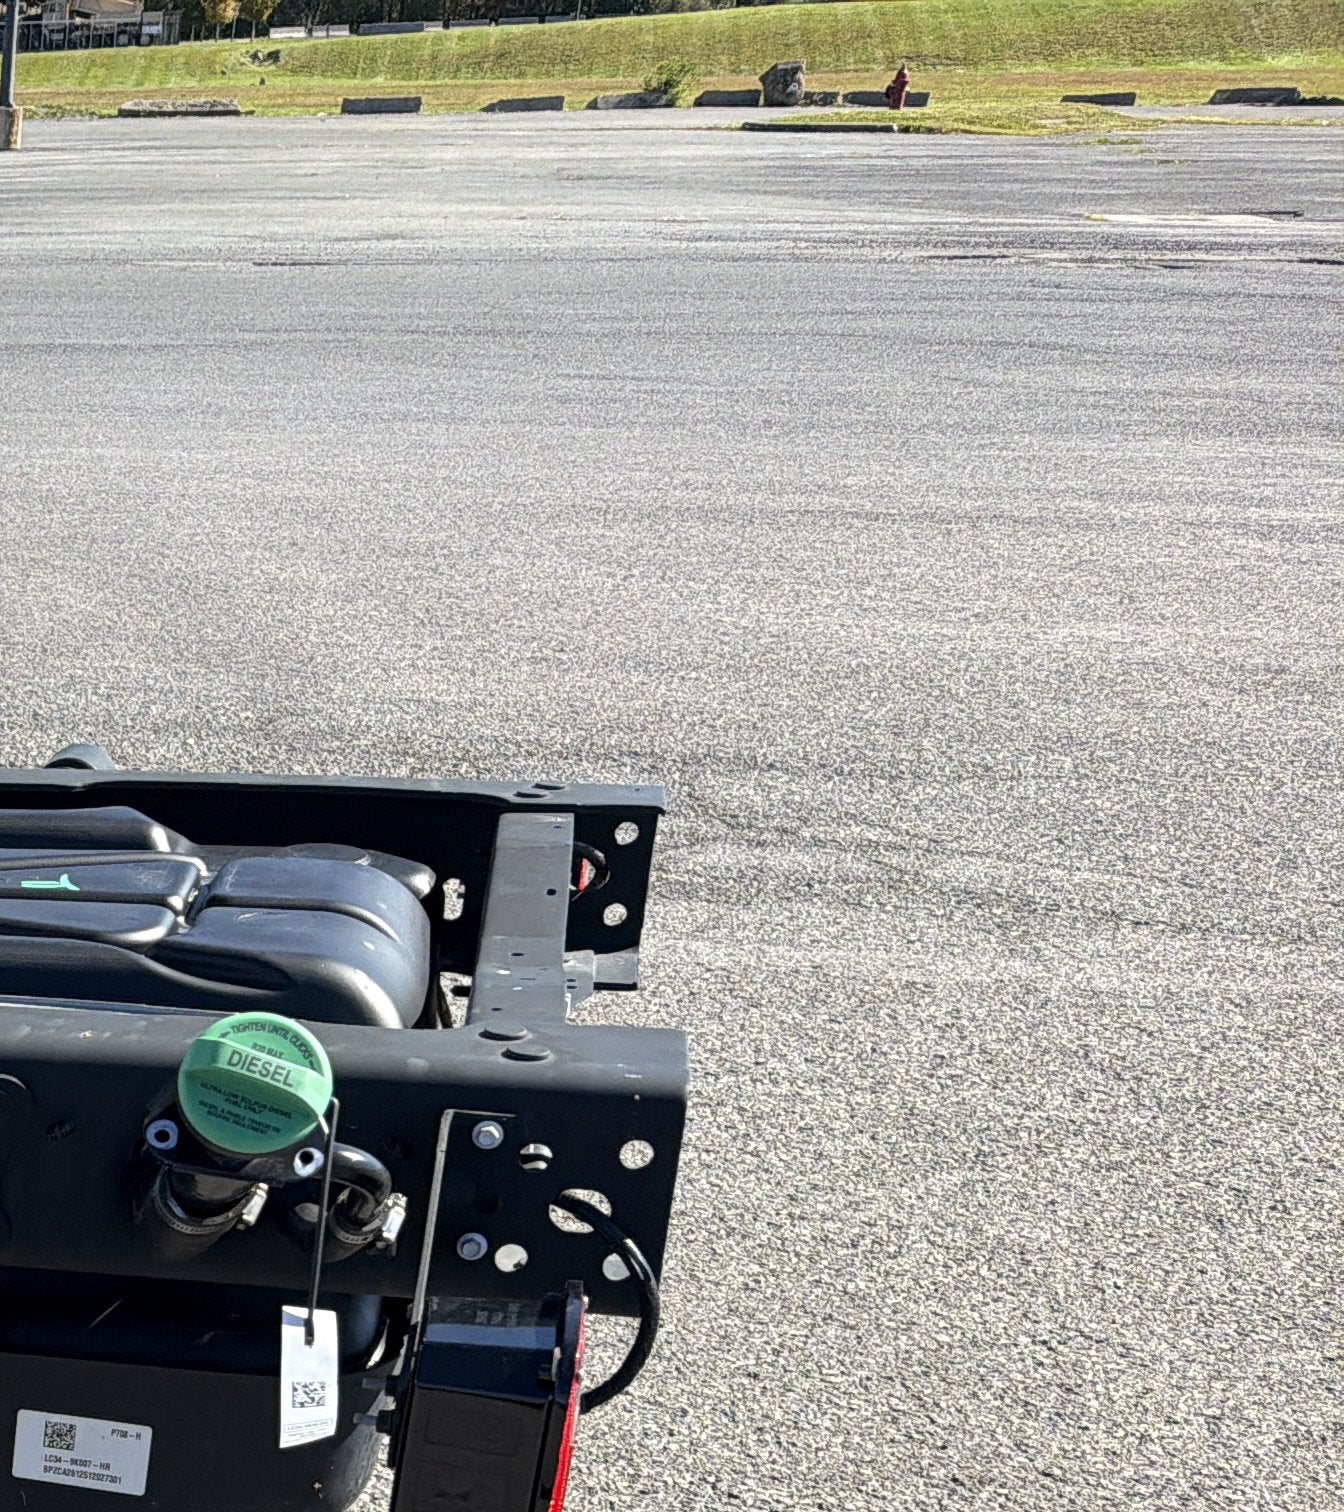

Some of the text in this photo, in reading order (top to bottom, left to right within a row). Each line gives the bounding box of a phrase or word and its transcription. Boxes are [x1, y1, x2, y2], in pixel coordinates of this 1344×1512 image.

[231, 1021, 313, 1060] TIGHTEN UNTIL CLICKS
[226, 1049, 294, 1088] DIESEL
